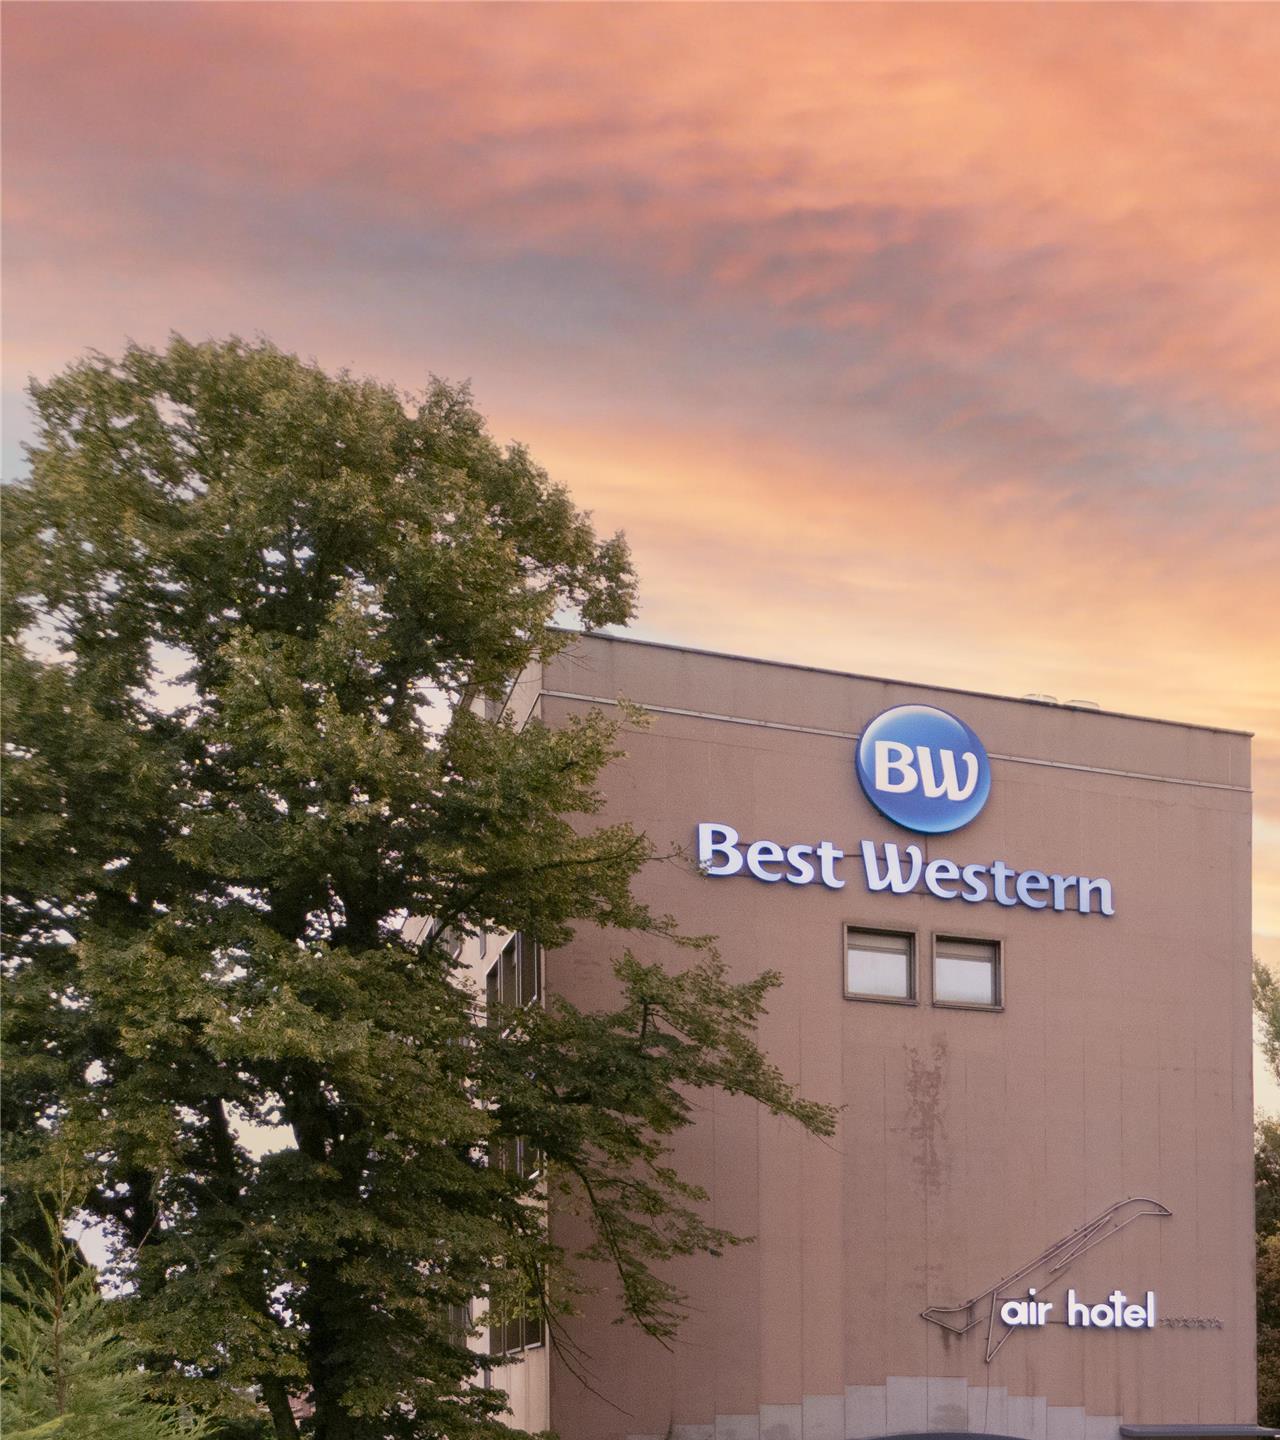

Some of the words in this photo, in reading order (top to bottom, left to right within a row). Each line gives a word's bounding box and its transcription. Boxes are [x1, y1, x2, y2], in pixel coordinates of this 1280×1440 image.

[874, 740, 979, 802] BW
[697, 822, 845, 889] Best
[859, 839, 1116, 916] Western
[1001, 1288, 1053, 1326] air
[1067, 1289, 1155, 1328] hotel
